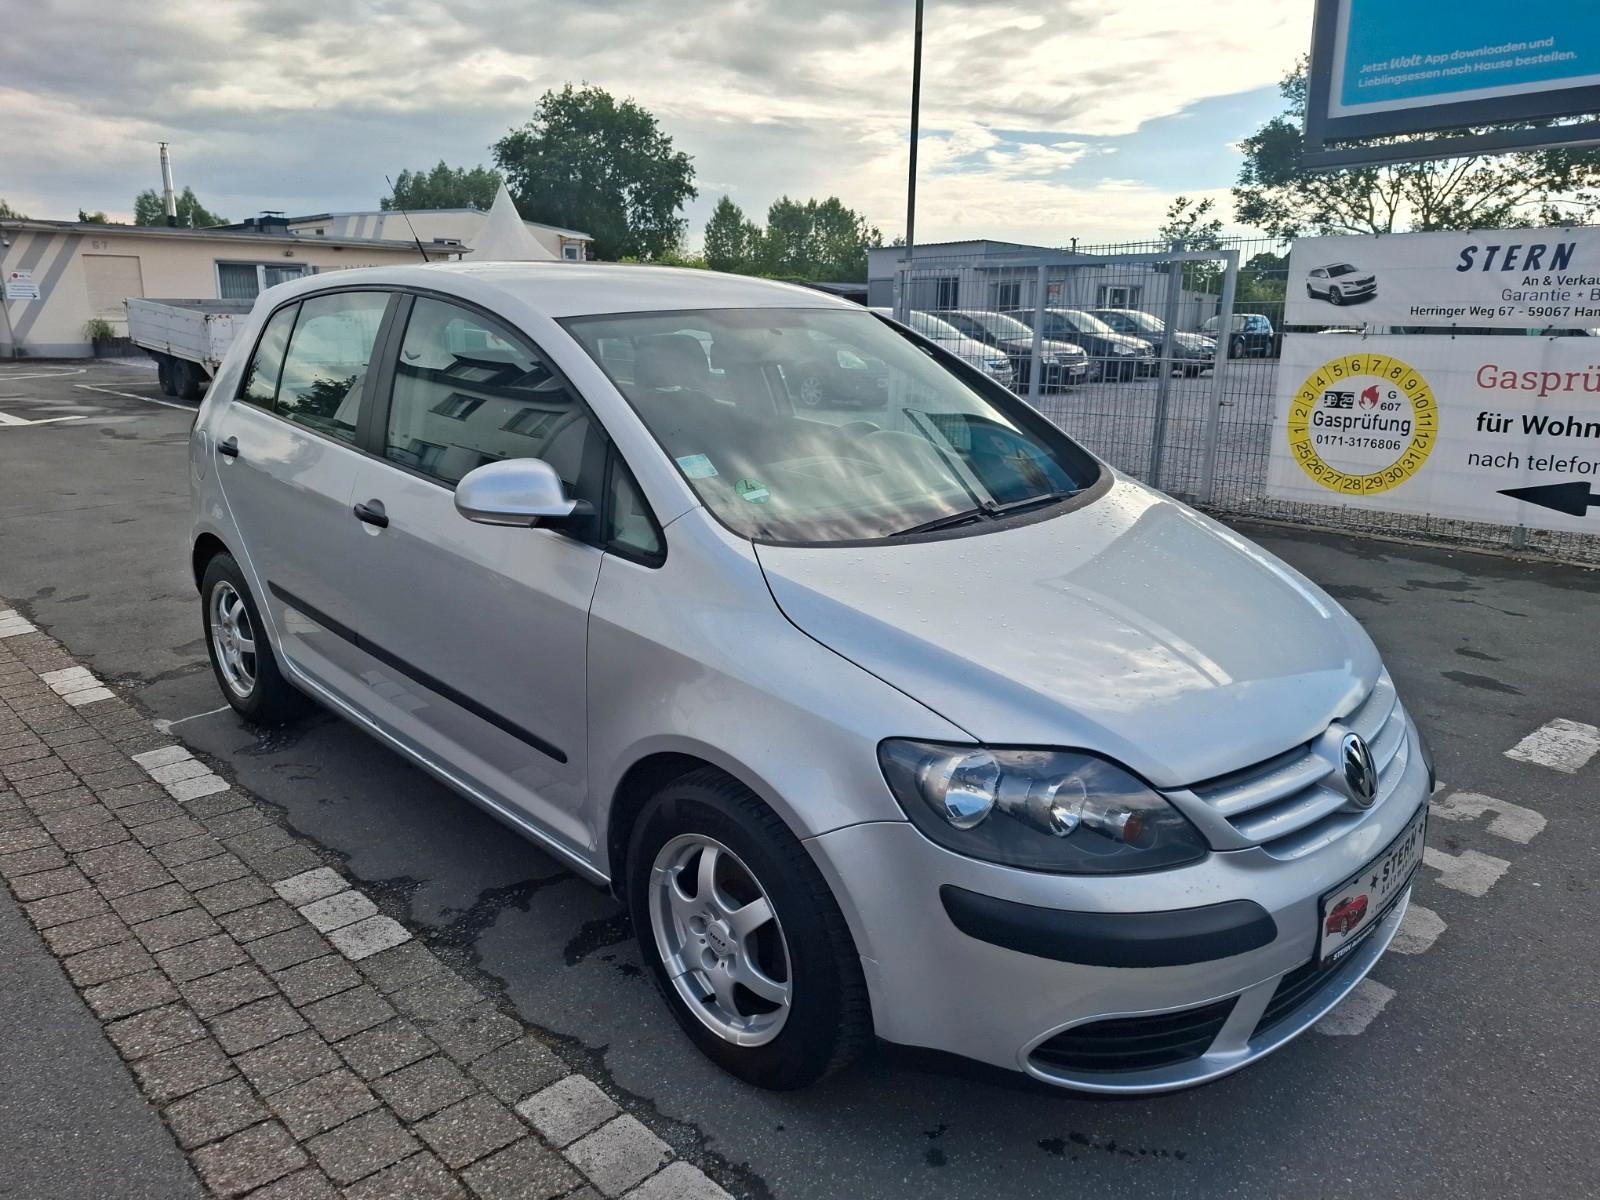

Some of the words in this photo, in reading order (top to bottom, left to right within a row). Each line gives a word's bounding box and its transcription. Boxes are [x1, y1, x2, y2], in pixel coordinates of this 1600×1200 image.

[1360, 61, 1389, 74] Jetzt
[1390, 54, 1424, 70] Wolt
[1424, 52, 1450, 66] App
[1450, 42, 1527, 59] downloaden
[1528, 36, 1555, 49] und
[1358, 70, 1440, 88] Lieblingsessen
[1442, 65, 1473, 77] nach
[1474, 59, 1514, 72] Hause
[1515, 50, 1578, 67] bestellen.
[1455, 242, 1577, 273] STERN
[1521, 275, 1540, 286] An
[1542, 275, 1552, 286] &
[1502, 288, 1571, 302] Garantie
[1590, 287, 1600, 301] B
[1410, 305, 1465, 318] Herringer
[1469, 305, 1494, 318] Weg
[1498, 305, 1514, 317] 67
[1527, 305, 1570, 318] 59067
[1333, 365, 1343, 377] 5
[1351, 360, 1361, 372] 6
[1372, 360, 1382, 372] 7
[1390, 367, 1402, 379] 8
[1315, 376, 1326, 388] 4
[1404, 378, 1417, 390] 9
[1476, 364, 1600, 397] Gasprü
[1302, 391, 1314, 401] 3
[1387, 390, 1397, 399] G
[1413, 393, 1429, 409] 10
[1295, 408, 1307, 418] 2
[1380, 402, 1401, 412] 607
[1313, 411, 1411, 436] Gasprüfung
[1418, 413, 1433, 427] 11
[1476, 411, 1513, 433] für
[1522, 414, 1600, 438] Wohn
[1316, 434, 1401, 450] 0171-3176806
[1413, 432, 1429, 449] 12
[1296, 442, 1312, 459] 25
[1306, 460, 1325, 475] 26
[1402, 452, 1420, 469] 31
[1468, 452, 1519, 469] nach
[1323, 471, 1342, 485] 27
[1384, 467, 1403, 483] 30
[1343, 478, 1361, 490] 28
[1365, 476, 1383, 490] 29
[1383, 827, 1417, 882] STERN
